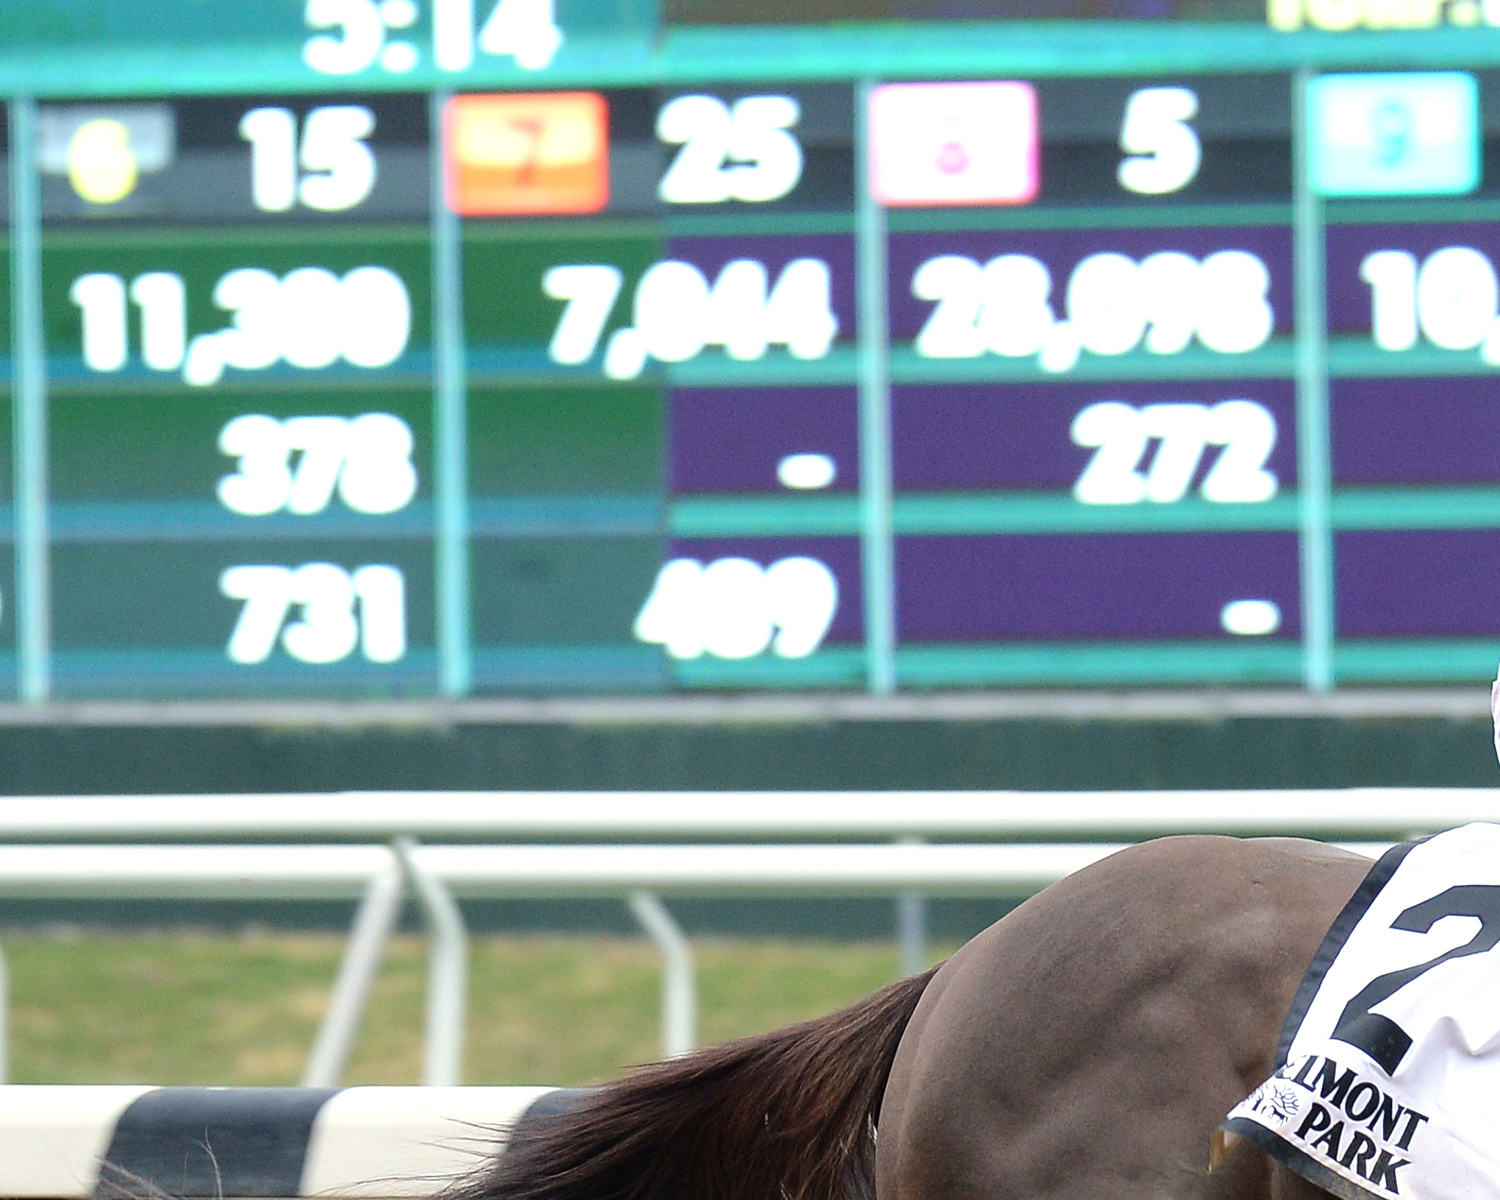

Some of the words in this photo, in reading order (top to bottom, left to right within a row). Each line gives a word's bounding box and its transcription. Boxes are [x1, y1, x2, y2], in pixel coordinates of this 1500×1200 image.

[242, 106, 376, 211] 15
[657, 95, 802, 203] 25
[1118, 87, 1200, 194] 5
[1071, 400, 1278, 505] 272
[220, 563, 406, 664] 731
[1293, 1101, 1412, 1195] PARK
